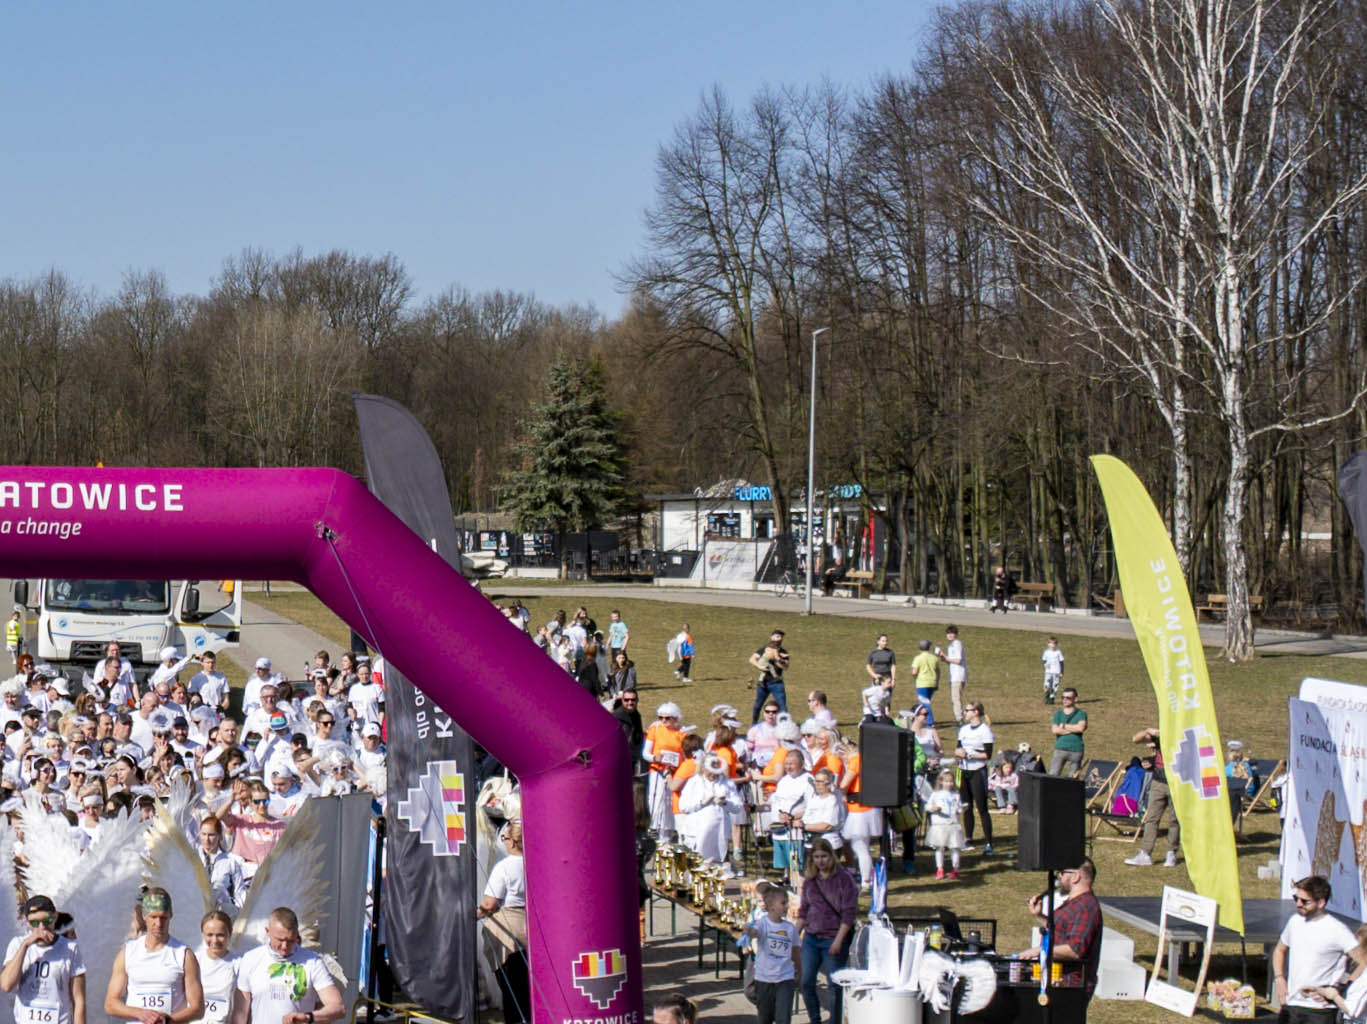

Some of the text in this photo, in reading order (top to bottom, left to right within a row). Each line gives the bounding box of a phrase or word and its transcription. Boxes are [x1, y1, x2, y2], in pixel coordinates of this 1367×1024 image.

[0, 519, 12, 534] a
[16, 517, 82, 540] change
[34, 960, 50, 978] 10
[142, 995, 164, 1008] 185
[29, 1009, 52, 1022] 116
